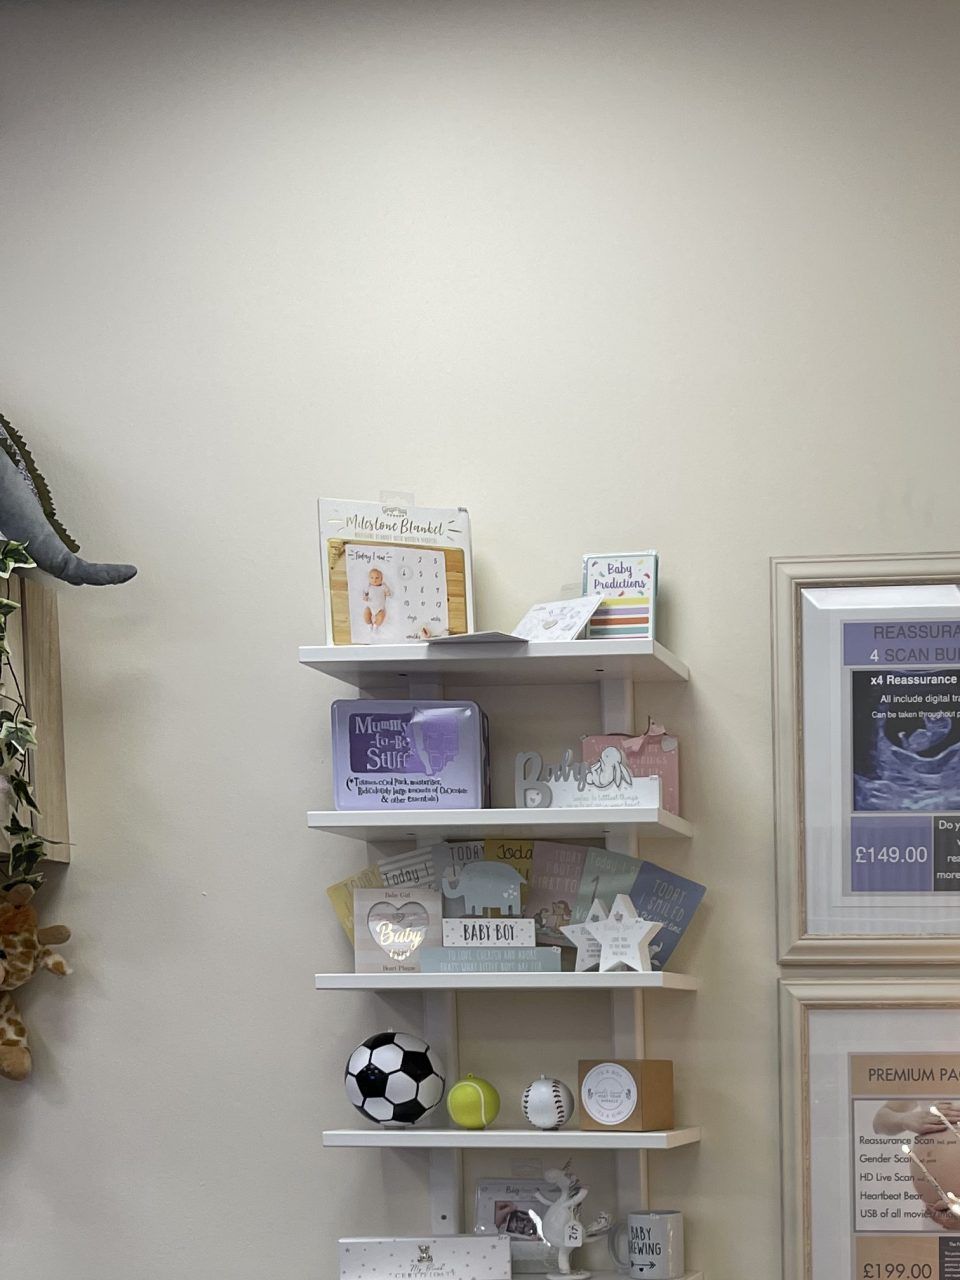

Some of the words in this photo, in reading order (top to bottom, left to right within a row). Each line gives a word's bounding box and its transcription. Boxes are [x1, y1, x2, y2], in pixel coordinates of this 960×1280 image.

[346, 514, 398, 531] Milestone
[400, 518, 444, 536] Blanket
[607, 561, 633, 578] Baby
[594, 578, 646, 590] Predictions
[870, 650, 879, 662] 4
[885, 648, 930, 662] SCAN
[870, 676, 884, 685] x4
[886, 674, 957, 685] Reassurance
[880, 695, 891, 703] All
[893, 694, 924, 703] include
[925, 694, 950, 704] digital
[871, 711, 886, 719] Can
[919, 710, 956, 719] throughout
[355, 716, 408, 735] Mummy
[515, 749, 592, 808] Baby
[938, 820, 953, 829] Do
[449, 844, 485, 861] TODAY
[496, 844, 533, 860] Toda
[855, 846, 928, 863] £149.00
[384, 870, 419, 885] Today
[653, 879, 687, 905] TODAY
[647, 898, 685, 922] SMILED
[376, 920, 423, 949] Baby
[463, 923, 491, 941] BABY
[496, 923, 515, 941] BOY
[868, 1068, 935, 1082] PREMIUM
[859, 1136, 911, 1145] Reassurance
[914, 1136, 935, 1145] Scan
[859, 1154, 892, 1163] Gender
[860, 1173, 873, 1182] HD
[876, 1173, 891, 1182] Live
[893, 1173, 914, 1182] Scan
[860, 1191, 901, 1200] Heartbeat
[904, 1191, 923, 1200] Bear
[860, 1209, 877, 1218] USB
[880, 1208, 888, 1218] of
[891, 1208, 901, 1218] all
[630, 1226, 651, 1240] BABY
[629, 1242, 662, 1255] REWING
[863, 1263, 932, 1279] £199.00
